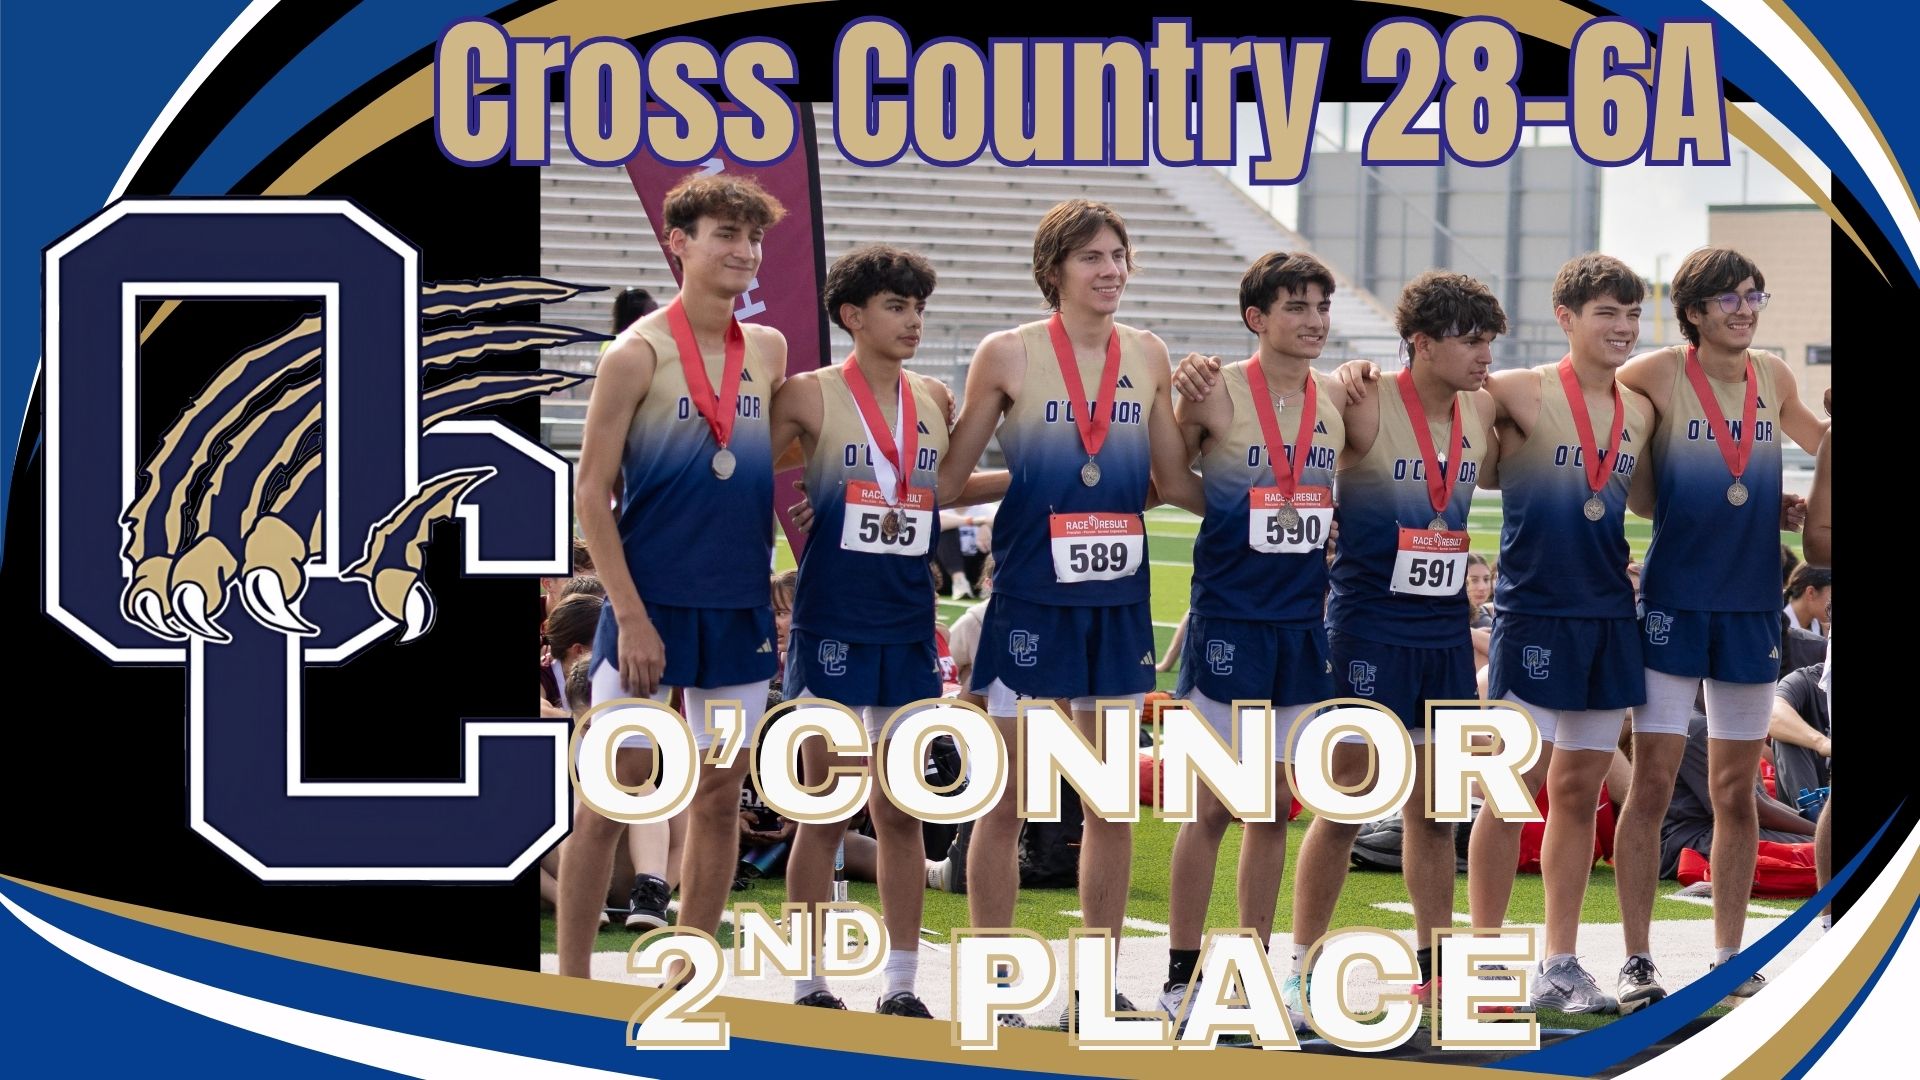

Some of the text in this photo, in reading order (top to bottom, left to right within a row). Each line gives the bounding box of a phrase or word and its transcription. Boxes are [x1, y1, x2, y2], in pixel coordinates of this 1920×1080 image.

[1296, 492, 1323, 502] RESULT
[1065, 519, 1129, 530] RACE RESULT
[1266, 514, 1321, 545] 590
[1412, 536, 1433, 546] RACE
[1441, 538, 1463, 548] RESULT
[1070, 542, 1129, 573] 589
[1408, 557, 1456, 588] 591
